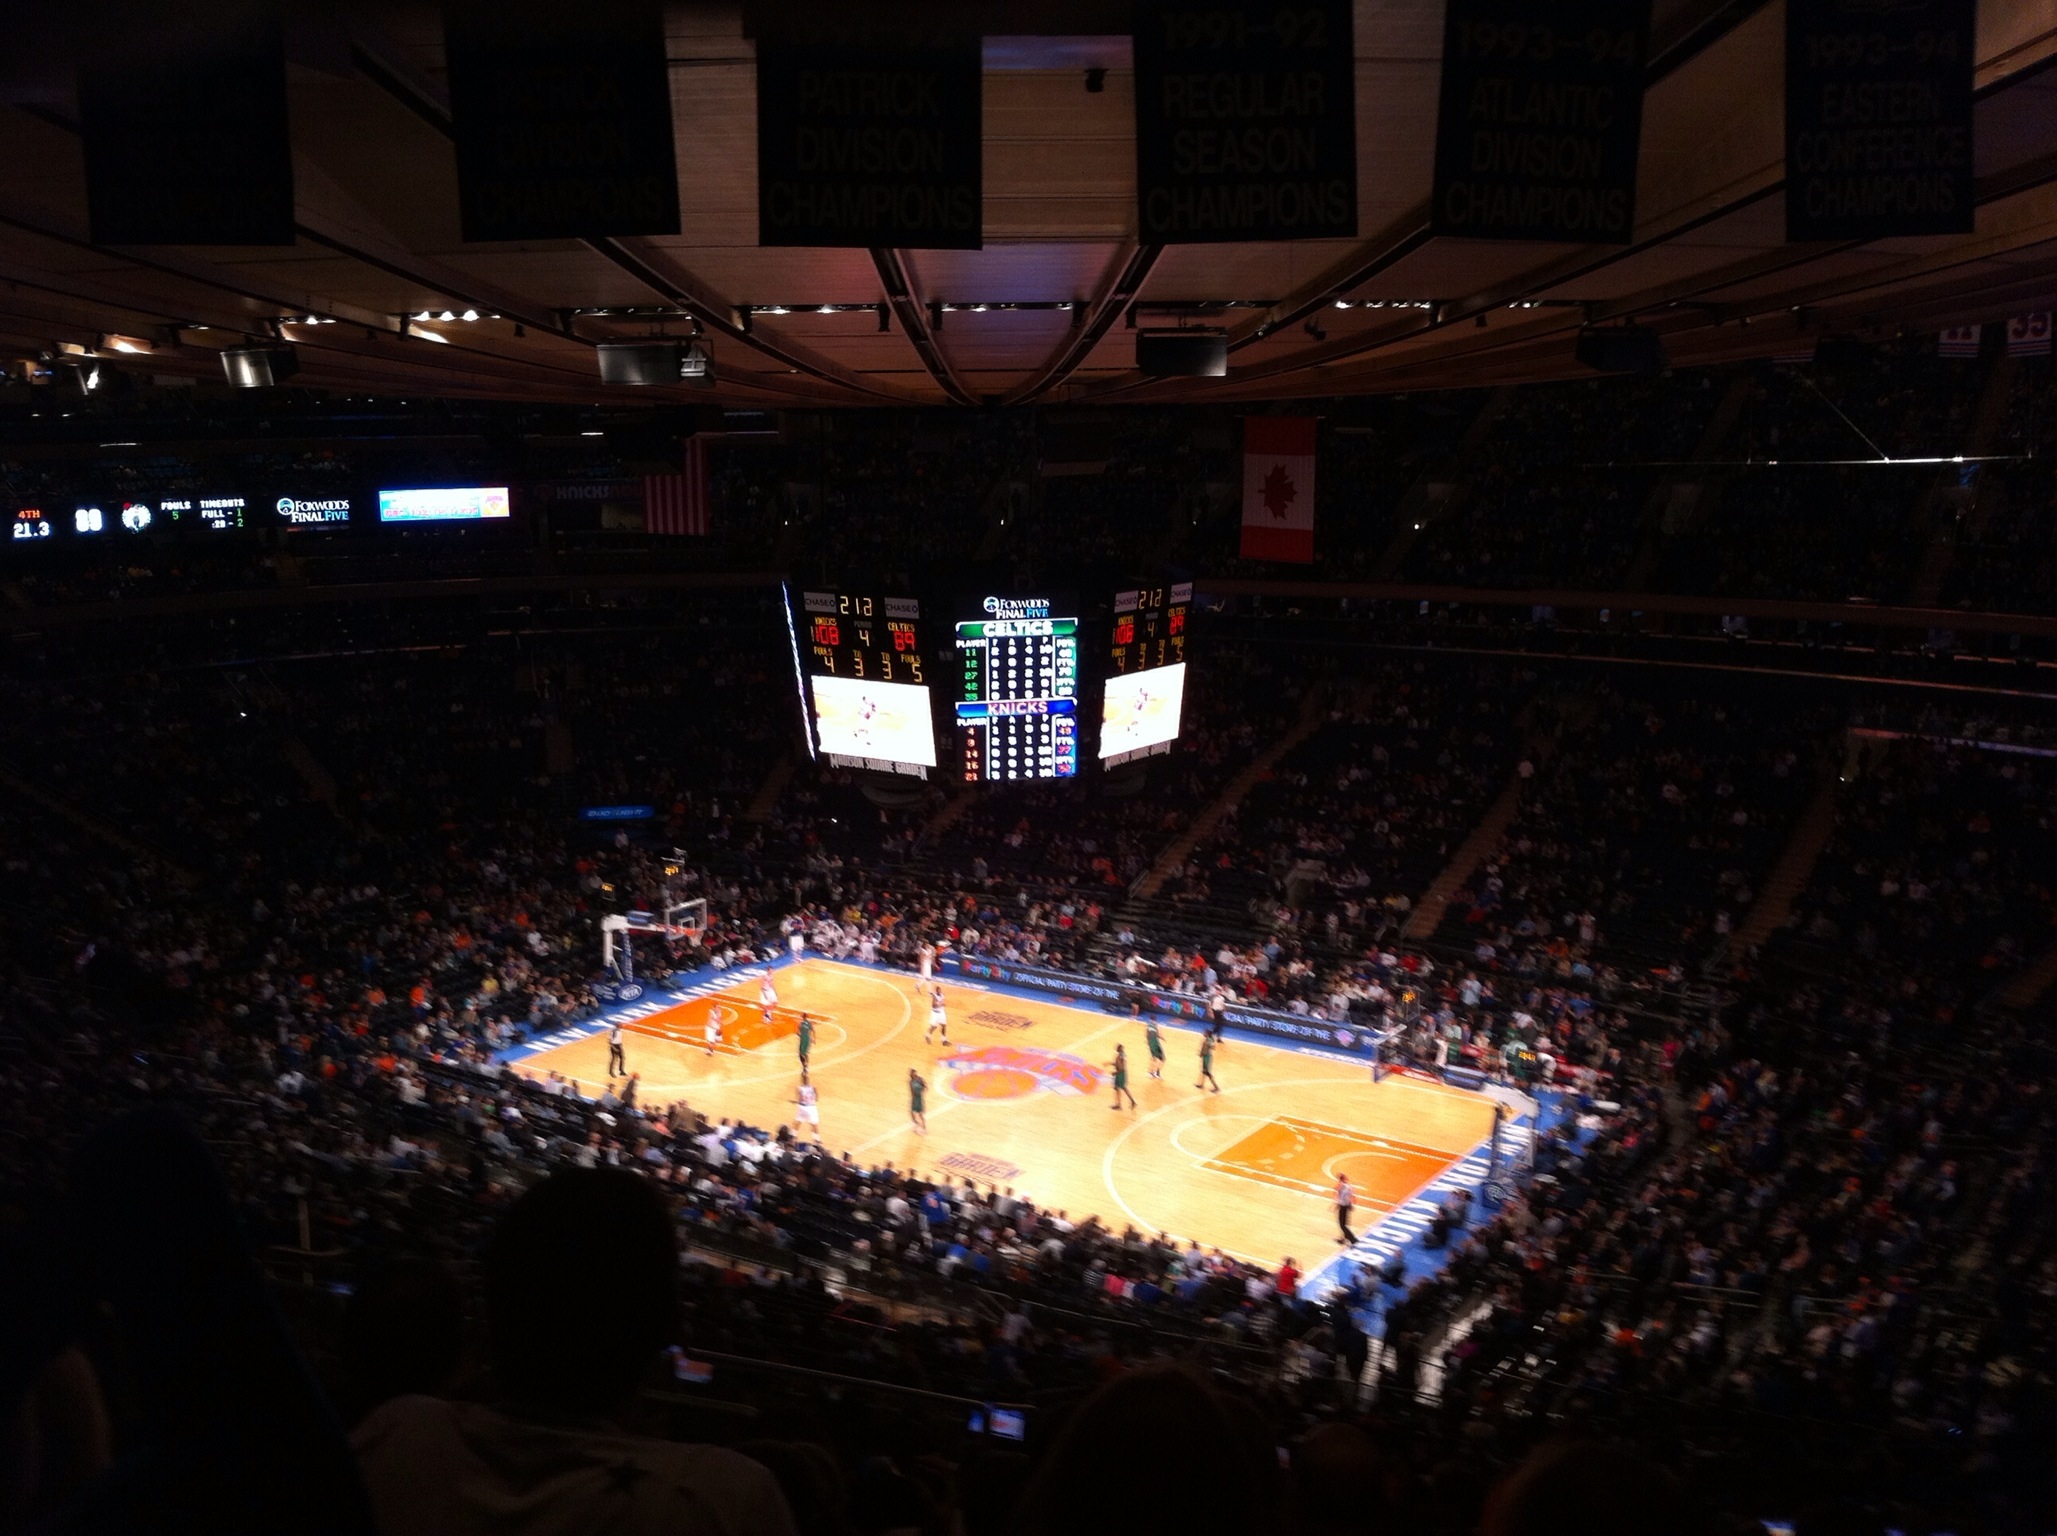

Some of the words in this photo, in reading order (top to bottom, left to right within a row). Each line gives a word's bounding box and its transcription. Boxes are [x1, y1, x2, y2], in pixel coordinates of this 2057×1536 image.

[800, 69, 942, 118] PATRICK
[1162, 72, 1327, 120] REGULAR
[1467, 77, 1614, 130] ATLANTIC
[1820, 81, 1943, 126] EASTERN
[797, 126, 945, 175] DIVISION
[1172, 128, 1317, 176] SEASON
[1470, 130, 1601, 179] DIVISION
[1798, 124, 1968, 173] CONFERENCE
[1807, 174, 1956, 220] CHAMPIONS
[767, 179, 975, 232] CHAMPIONS
[1150, 179, 1350, 234] CHAMPIONS
[1444, 181, 1627, 233] CHAMPIONS
[160, 501, 192, 511] FOULS
[199, 498, 245, 509] TIMEOUTS
[294, 500, 350, 512] FOXWOODS
[19, 509, 41, 519] 4TH
[172, 511, 180, 520] 5
[201, 509, 226, 519] FULL
[237, 508, 243, 517] 1
[291, 511, 325, 523] FINAL
[325, 509, 350, 521] FIVE
[13, 521, 50, 538] 21.3
[237, 518, 244, 528] 2
[805, 599, 830, 607] CHASE
[885, 603, 912, 613] CHASE
[1000, 598, 1050, 610] FOXWOODS
[996, 608, 1026, 620] FINAL
[1025, 608, 1049, 619] FIVE
[887, 622, 915, 633] CELTICS
[983, 621, 1054, 638] CELTICS
[1147, 621, 1155, 638] 4
[1169, 615, 1184, 636] 89
[859, 630, 870, 647] 4
[893, 630, 916, 651] 89
[956, 638, 987, 649] PLAYER
[965, 648, 977, 657] 11
[1157, 648, 1164, 666] 3
[824, 656, 835, 674] 4
[854, 657, 864, 677] 3
[965, 660, 978, 669] 12
[1117, 657, 1125, 673] 4
[1138, 651, 1146, 670] 3
[882, 660, 892, 680] 3
[911, 663, 923, 683] 5
[965, 671, 978, 680] 27
[965, 682, 978, 691] 42
[965, 693, 978, 701] 55
[988, 701, 1049, 715] KNICKS
[956, 717, 987, 727] PLAYER
[967, 727, 975, 735] 4
[965, 750, 979, 759] 14
[966, 761, 979, 770] 16
[965, 772, 978, 781] 21
